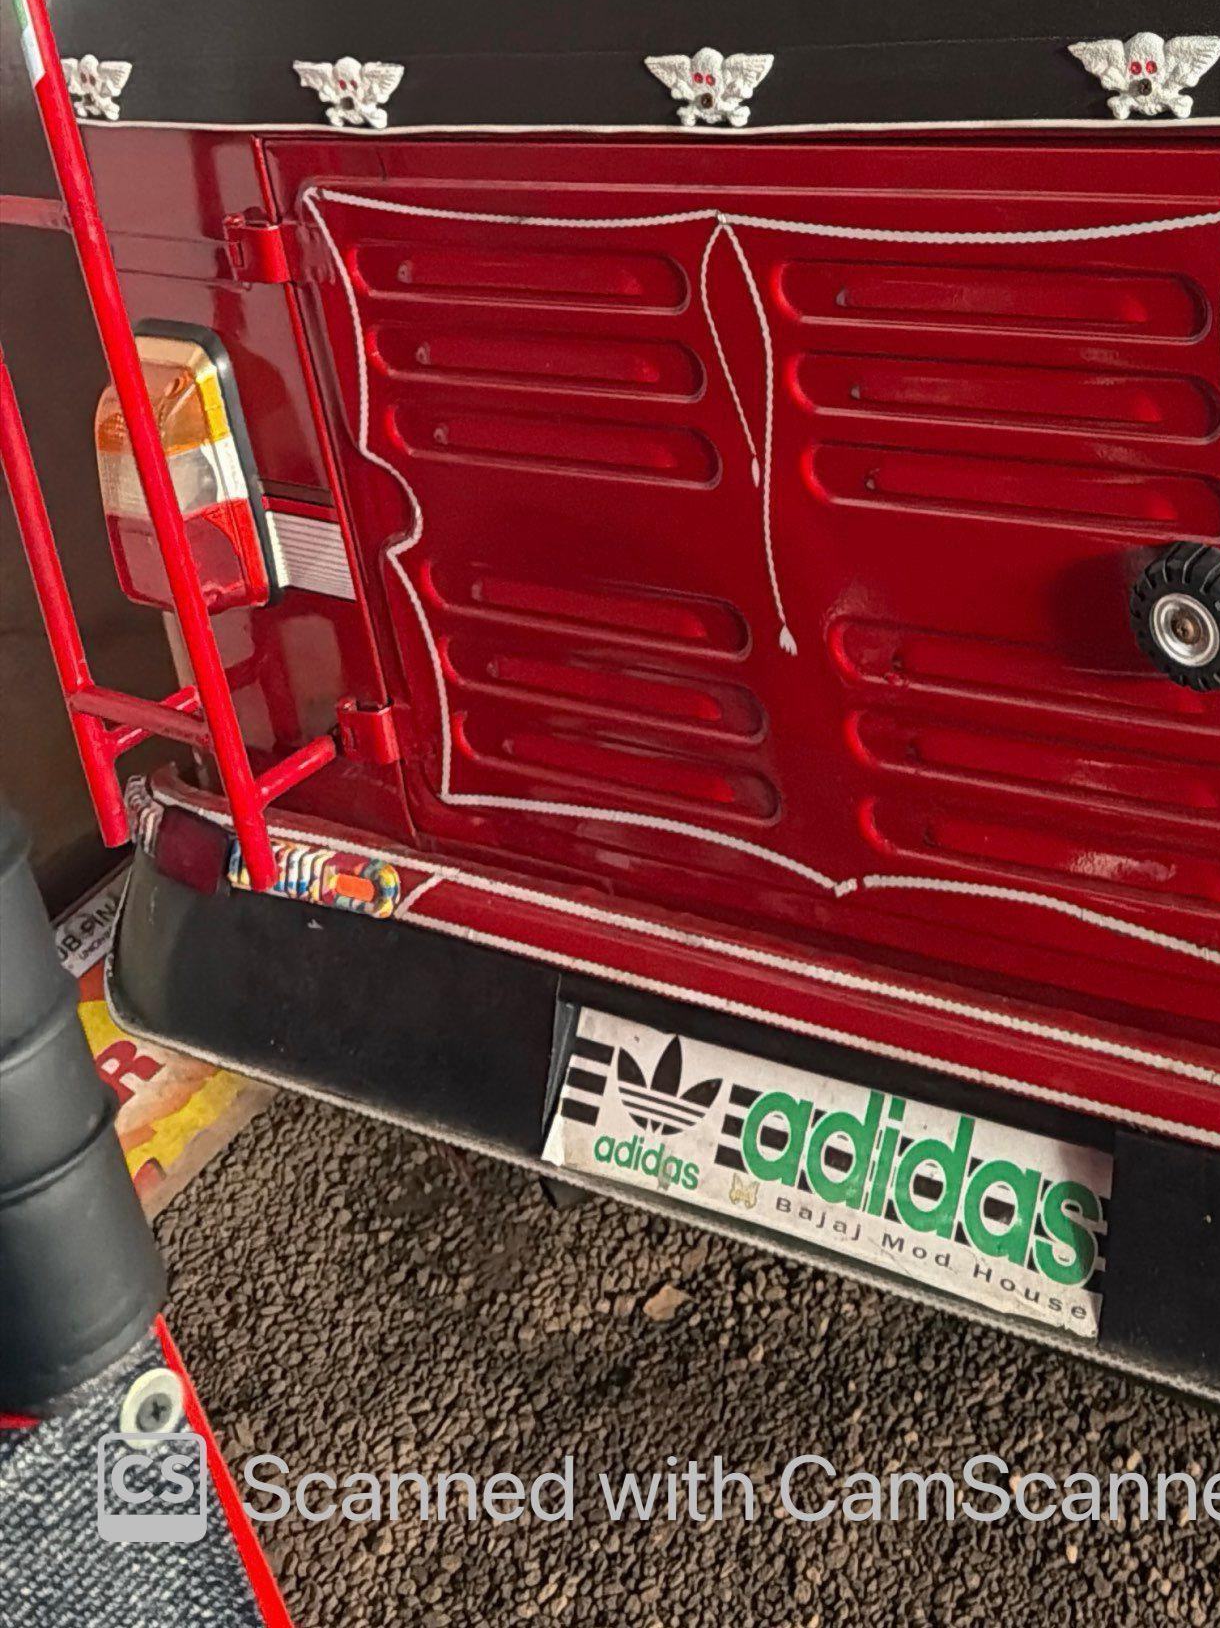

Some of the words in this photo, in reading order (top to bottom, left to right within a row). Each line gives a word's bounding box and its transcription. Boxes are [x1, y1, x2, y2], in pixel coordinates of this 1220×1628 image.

[594, 1132, 699, 1189] adidas
[741, 1091, 1102, 1286] adidas
[881, 1231, 952, 1268] Mod
[973, 1264, 1089, 1321] House
